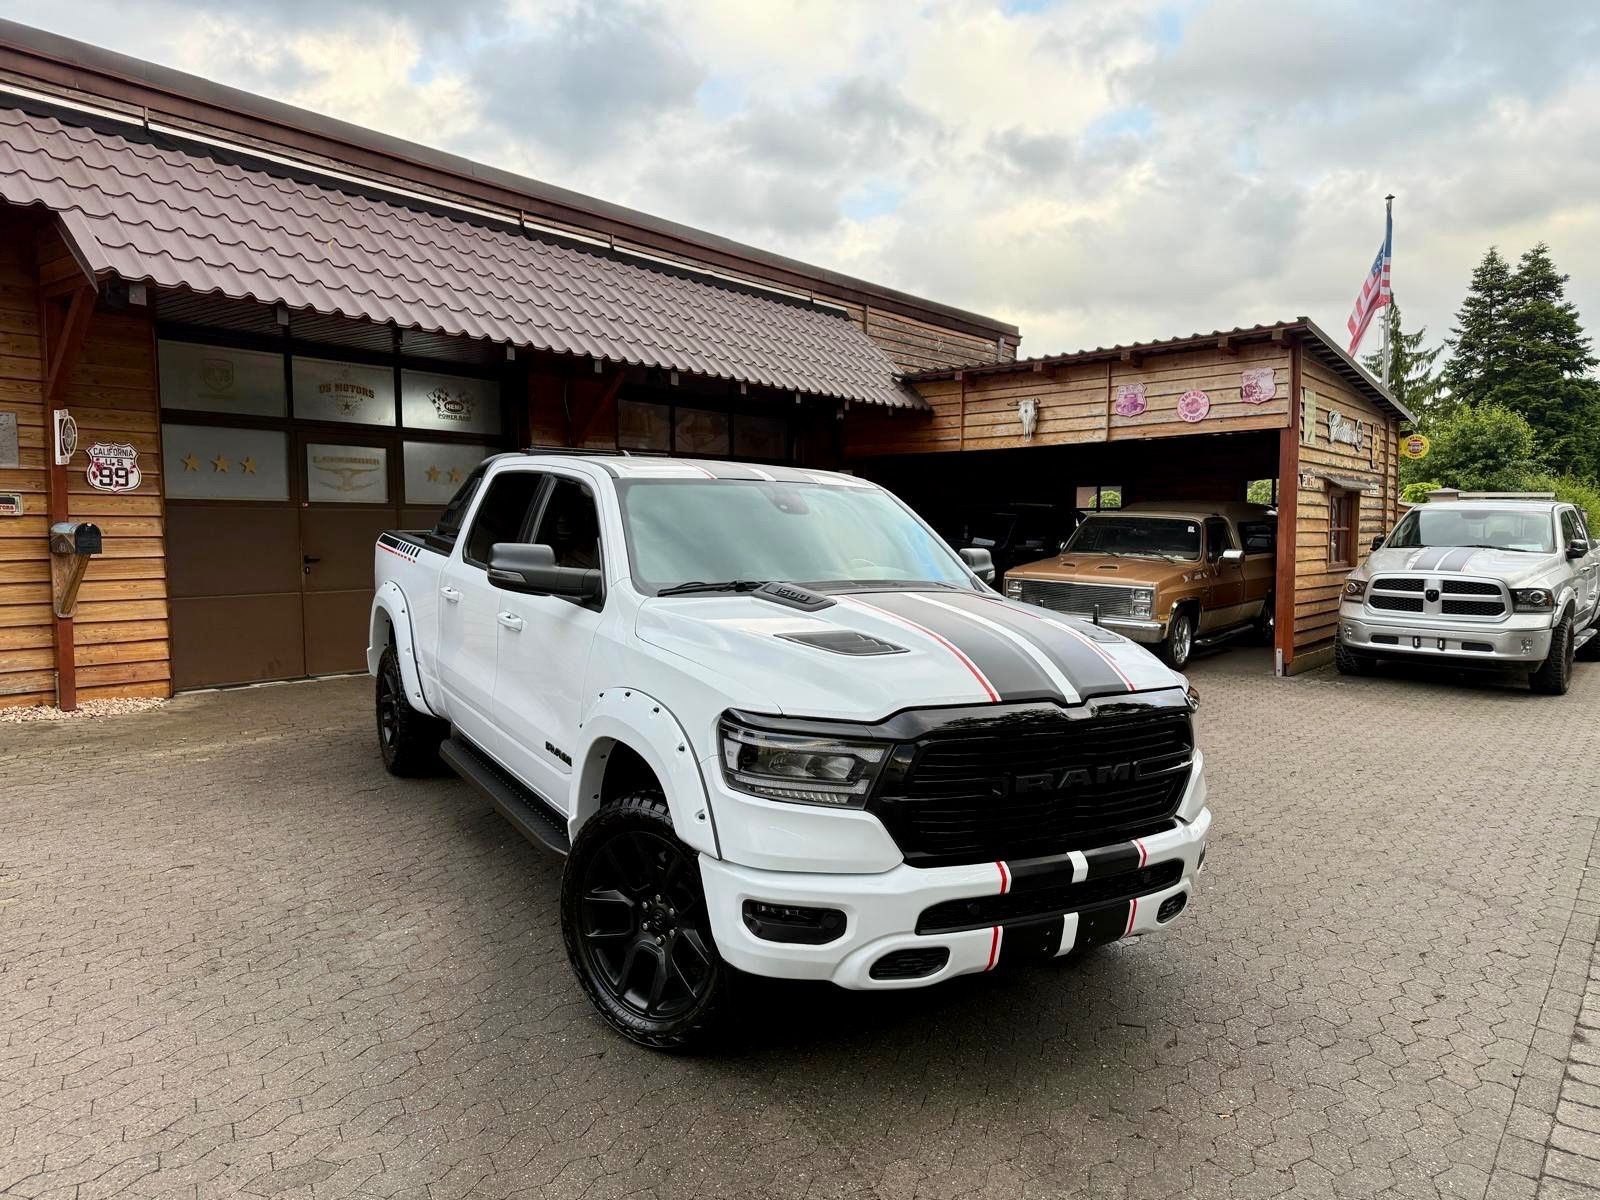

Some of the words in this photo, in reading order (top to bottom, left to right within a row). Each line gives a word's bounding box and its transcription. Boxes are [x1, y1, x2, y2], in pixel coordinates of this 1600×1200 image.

[334, 383, 376, 399] MOTORS
[93, 447, 134, 457] CALIFORNIA
[99, 466, 129, 487] 99
[775, 587, 811, 602] 1500
[1015, 762, 1132, 793] RAM
